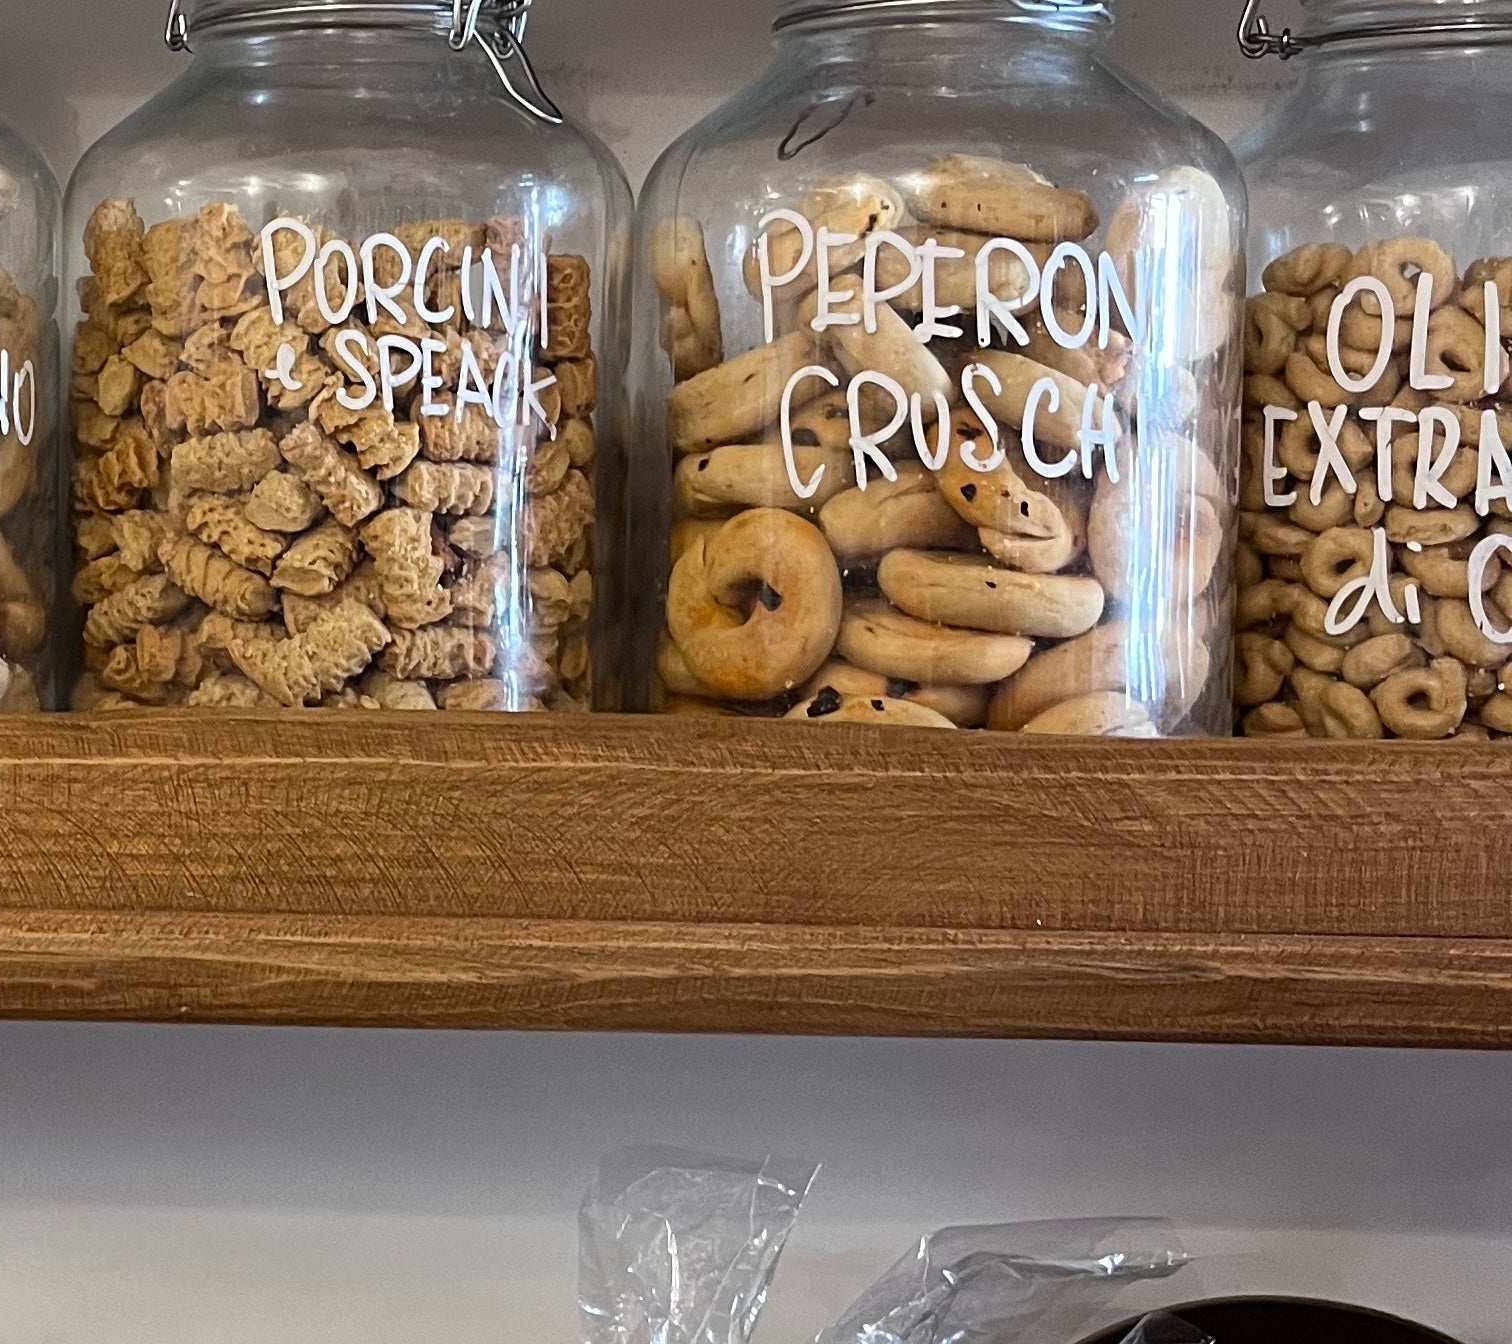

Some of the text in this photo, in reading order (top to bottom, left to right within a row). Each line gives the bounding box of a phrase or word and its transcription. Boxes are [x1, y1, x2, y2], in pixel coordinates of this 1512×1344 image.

[260, 217, 548, 350] PORCINI
[1262, 400, 1512, 517] EXTRA
[1324, 526, 1422, 637] di
